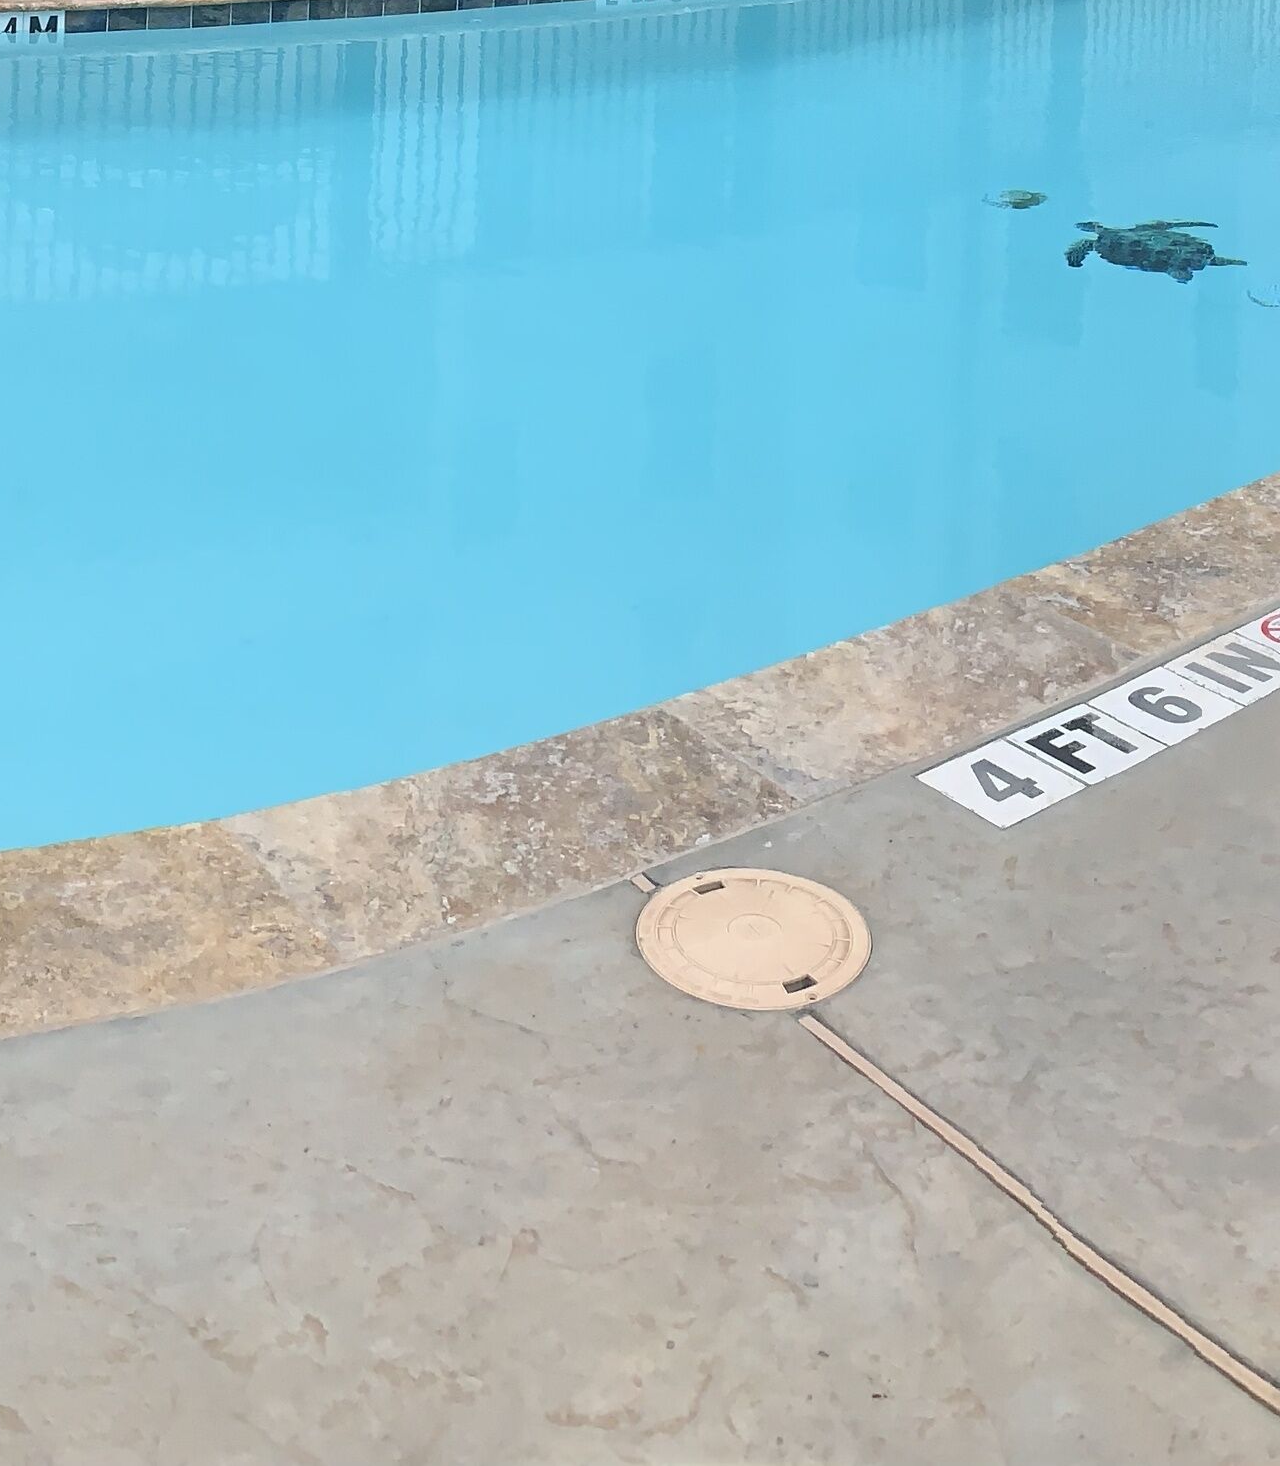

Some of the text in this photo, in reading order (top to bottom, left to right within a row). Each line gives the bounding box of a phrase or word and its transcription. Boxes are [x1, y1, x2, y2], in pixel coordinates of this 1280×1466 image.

[970, 758, 1046, 803] 4
[1025, 714, 1139, 774] FT
[1127, 686, 1203, 724] 6
